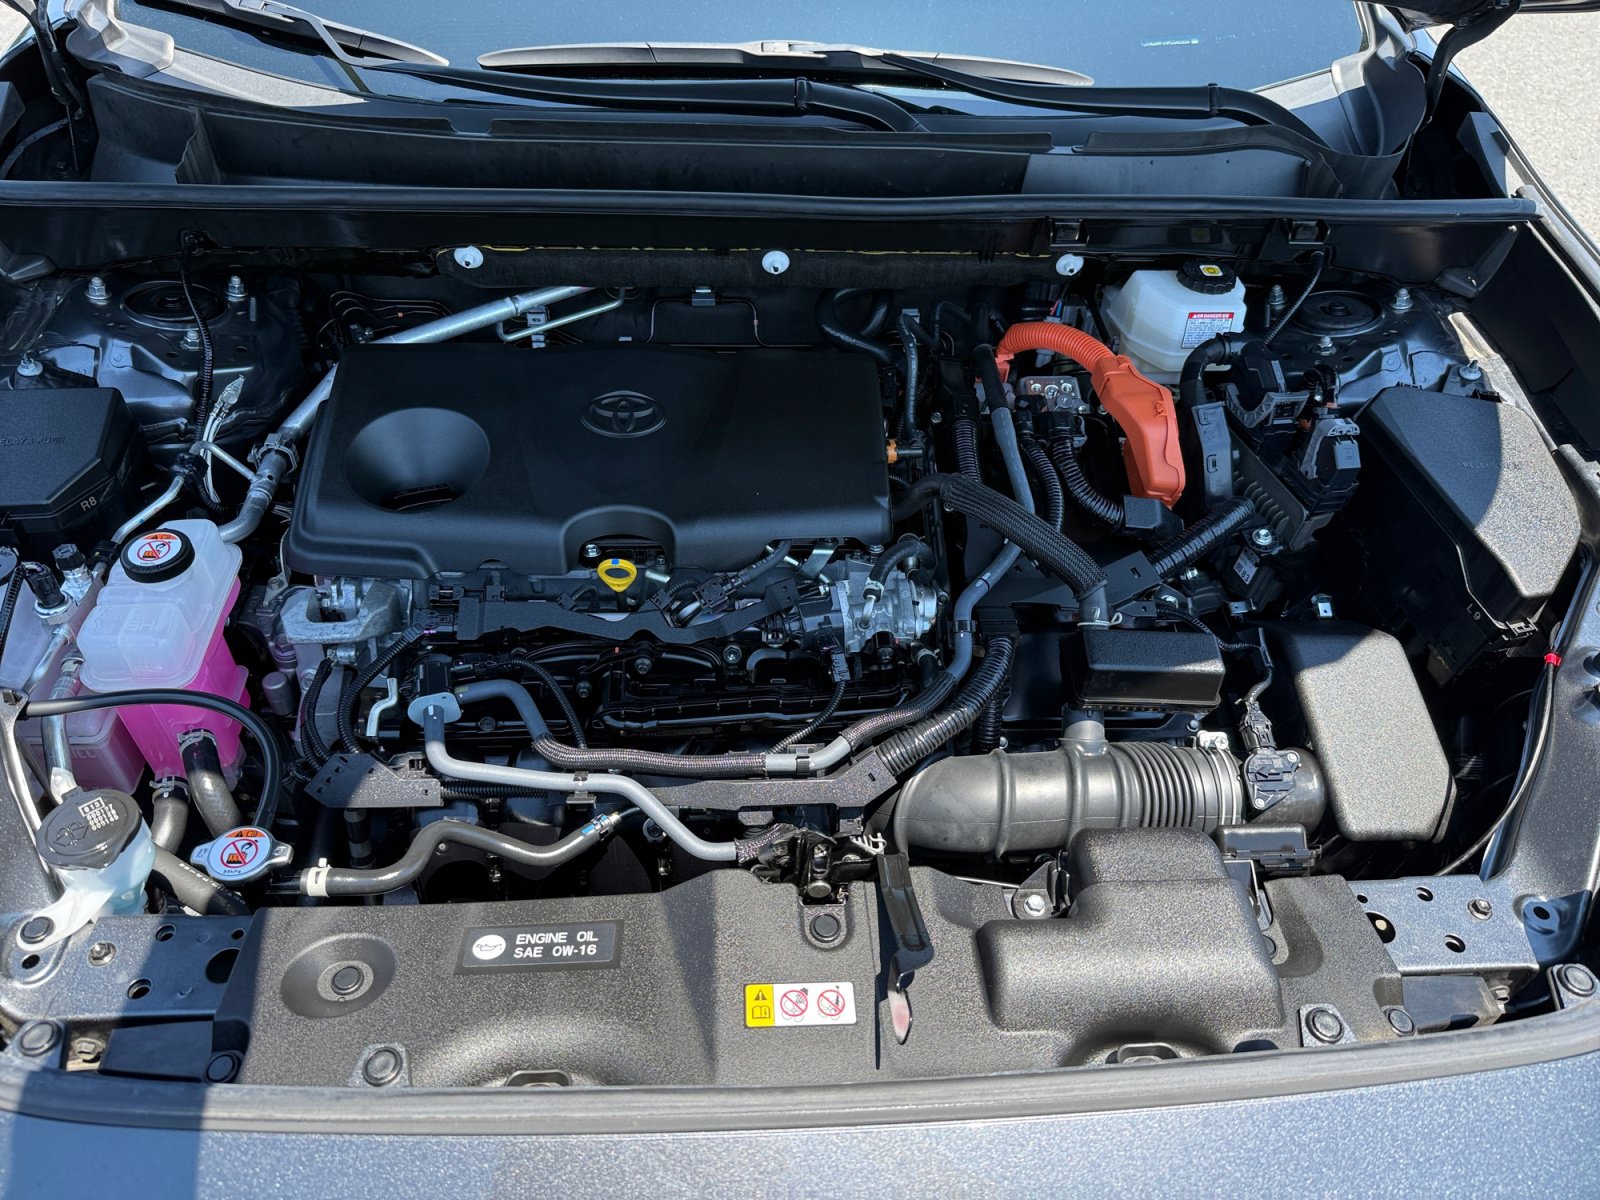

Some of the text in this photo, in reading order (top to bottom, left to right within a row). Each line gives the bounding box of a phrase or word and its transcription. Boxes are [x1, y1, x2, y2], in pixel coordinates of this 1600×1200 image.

[80, 496, 97, 511] R8
[515, 931, 599, 945] ENGINE OIL
[513, 944, 597, 959] SAE 0W-16
